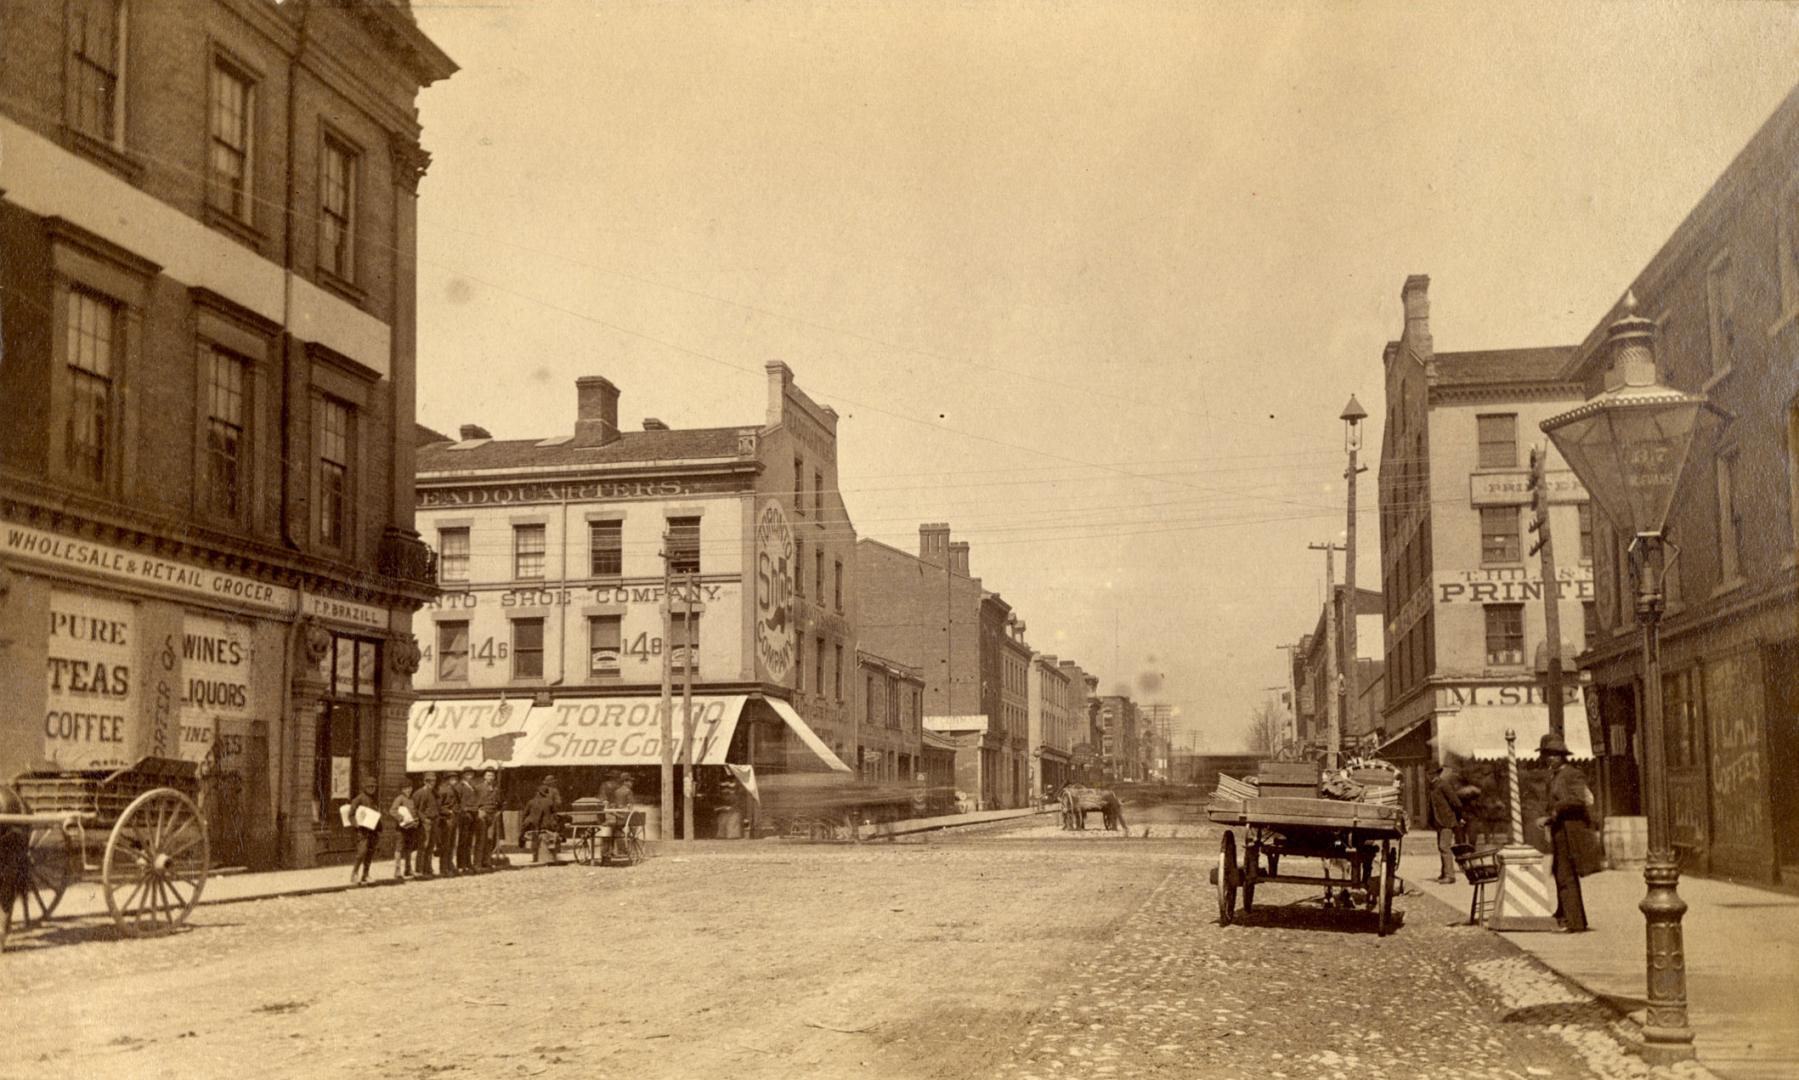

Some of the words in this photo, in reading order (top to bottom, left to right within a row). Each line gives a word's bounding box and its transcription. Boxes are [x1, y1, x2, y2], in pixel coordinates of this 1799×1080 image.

[8, 529, 122, 571] WHOLESALE
[125, 560, 138, 574] &
[141, 560, 202, 588] RETAIL
[212, 576, 273, 600] GROCER
[501, 591, 572, 607] SHOE
[51, 612, 127, 645] PURE
[183, 634, 241, 666] WINES
[470, 636, 508, 667] 146
[623, 631, 662, 661] 148
[48, 657, 129, 696] TEAS
[46, 711, 124, 742] COFFEE
[536, 731, 617, 759] Shoe
